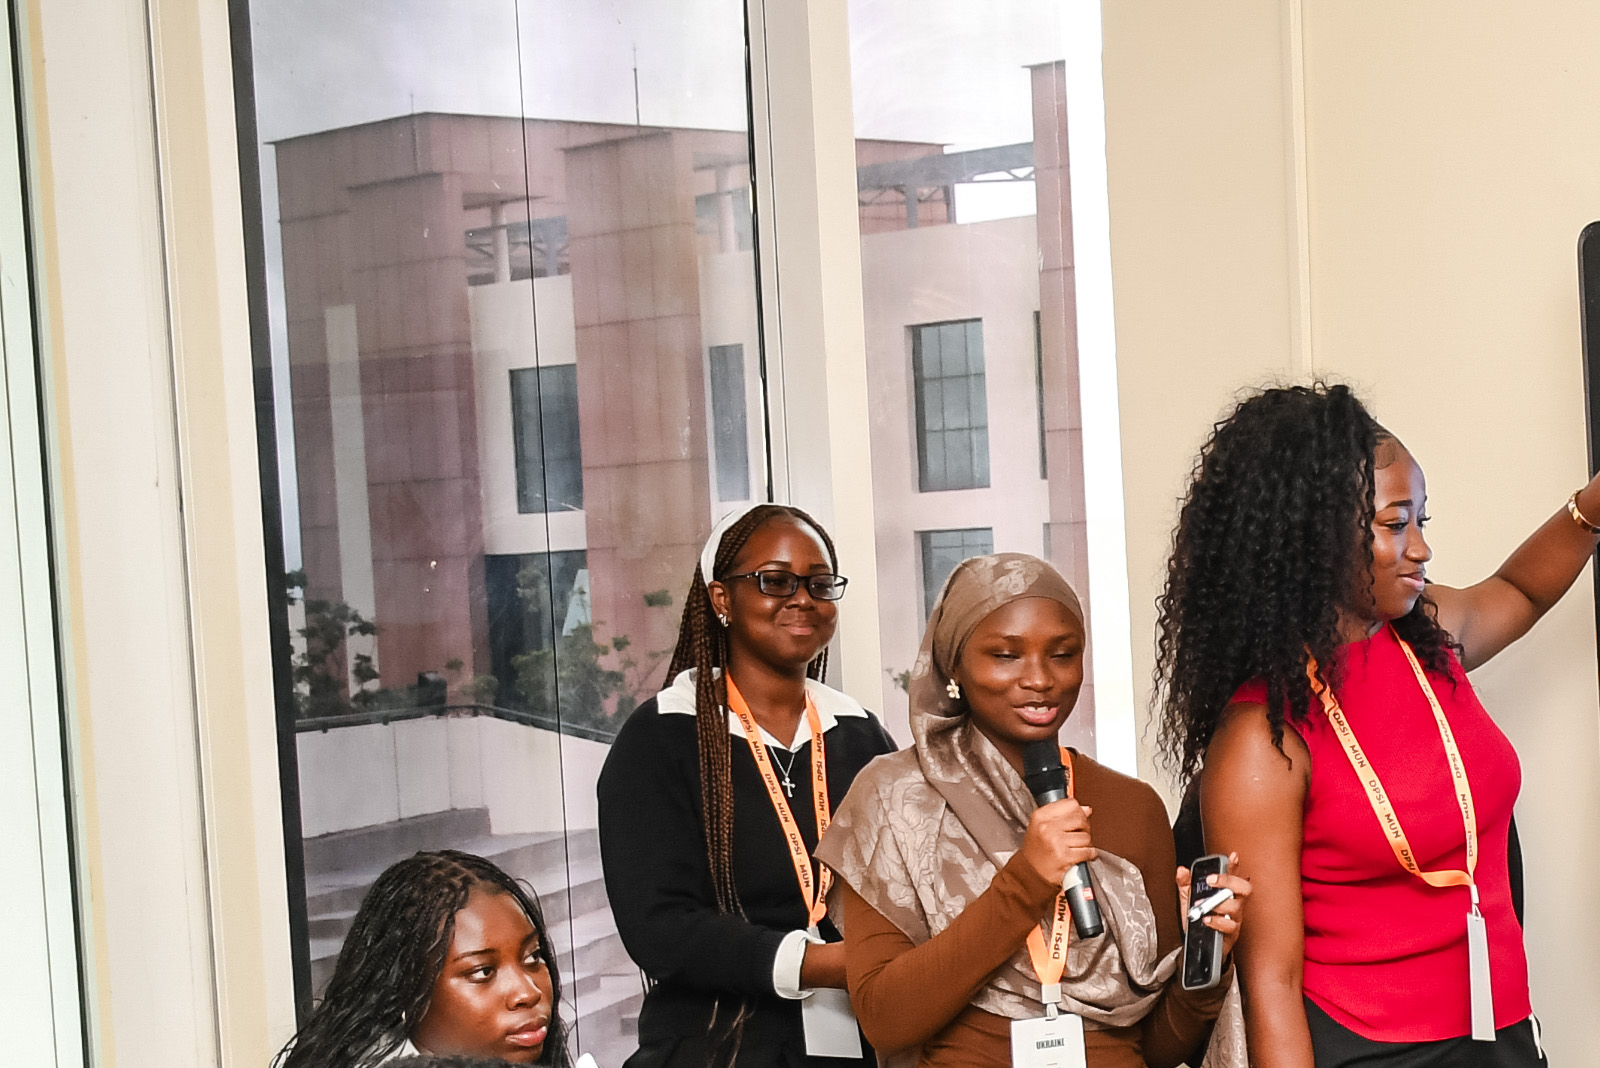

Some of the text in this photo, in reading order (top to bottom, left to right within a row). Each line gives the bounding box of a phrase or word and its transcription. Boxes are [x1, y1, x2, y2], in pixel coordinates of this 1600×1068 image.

[741, 713, 764, 762] DPSI MUN
[1333, 712, 1366, 768] DPSI MUN
[1451, 753, 1462, 779] DPSI
[765, 773, 790, 823] DPSI MUN
[1368, 779, 1401, 839] DPSI MUN
[1461, 794, 1469, 820] MUN
[790, 833, 811, 888] DPSI MUN
[1400, 849, 1416, 871] DPSI
[1052, 895, 1067, 960] DPSI MUN
[1036, 1038, 1064, 1050] UKRAINE
